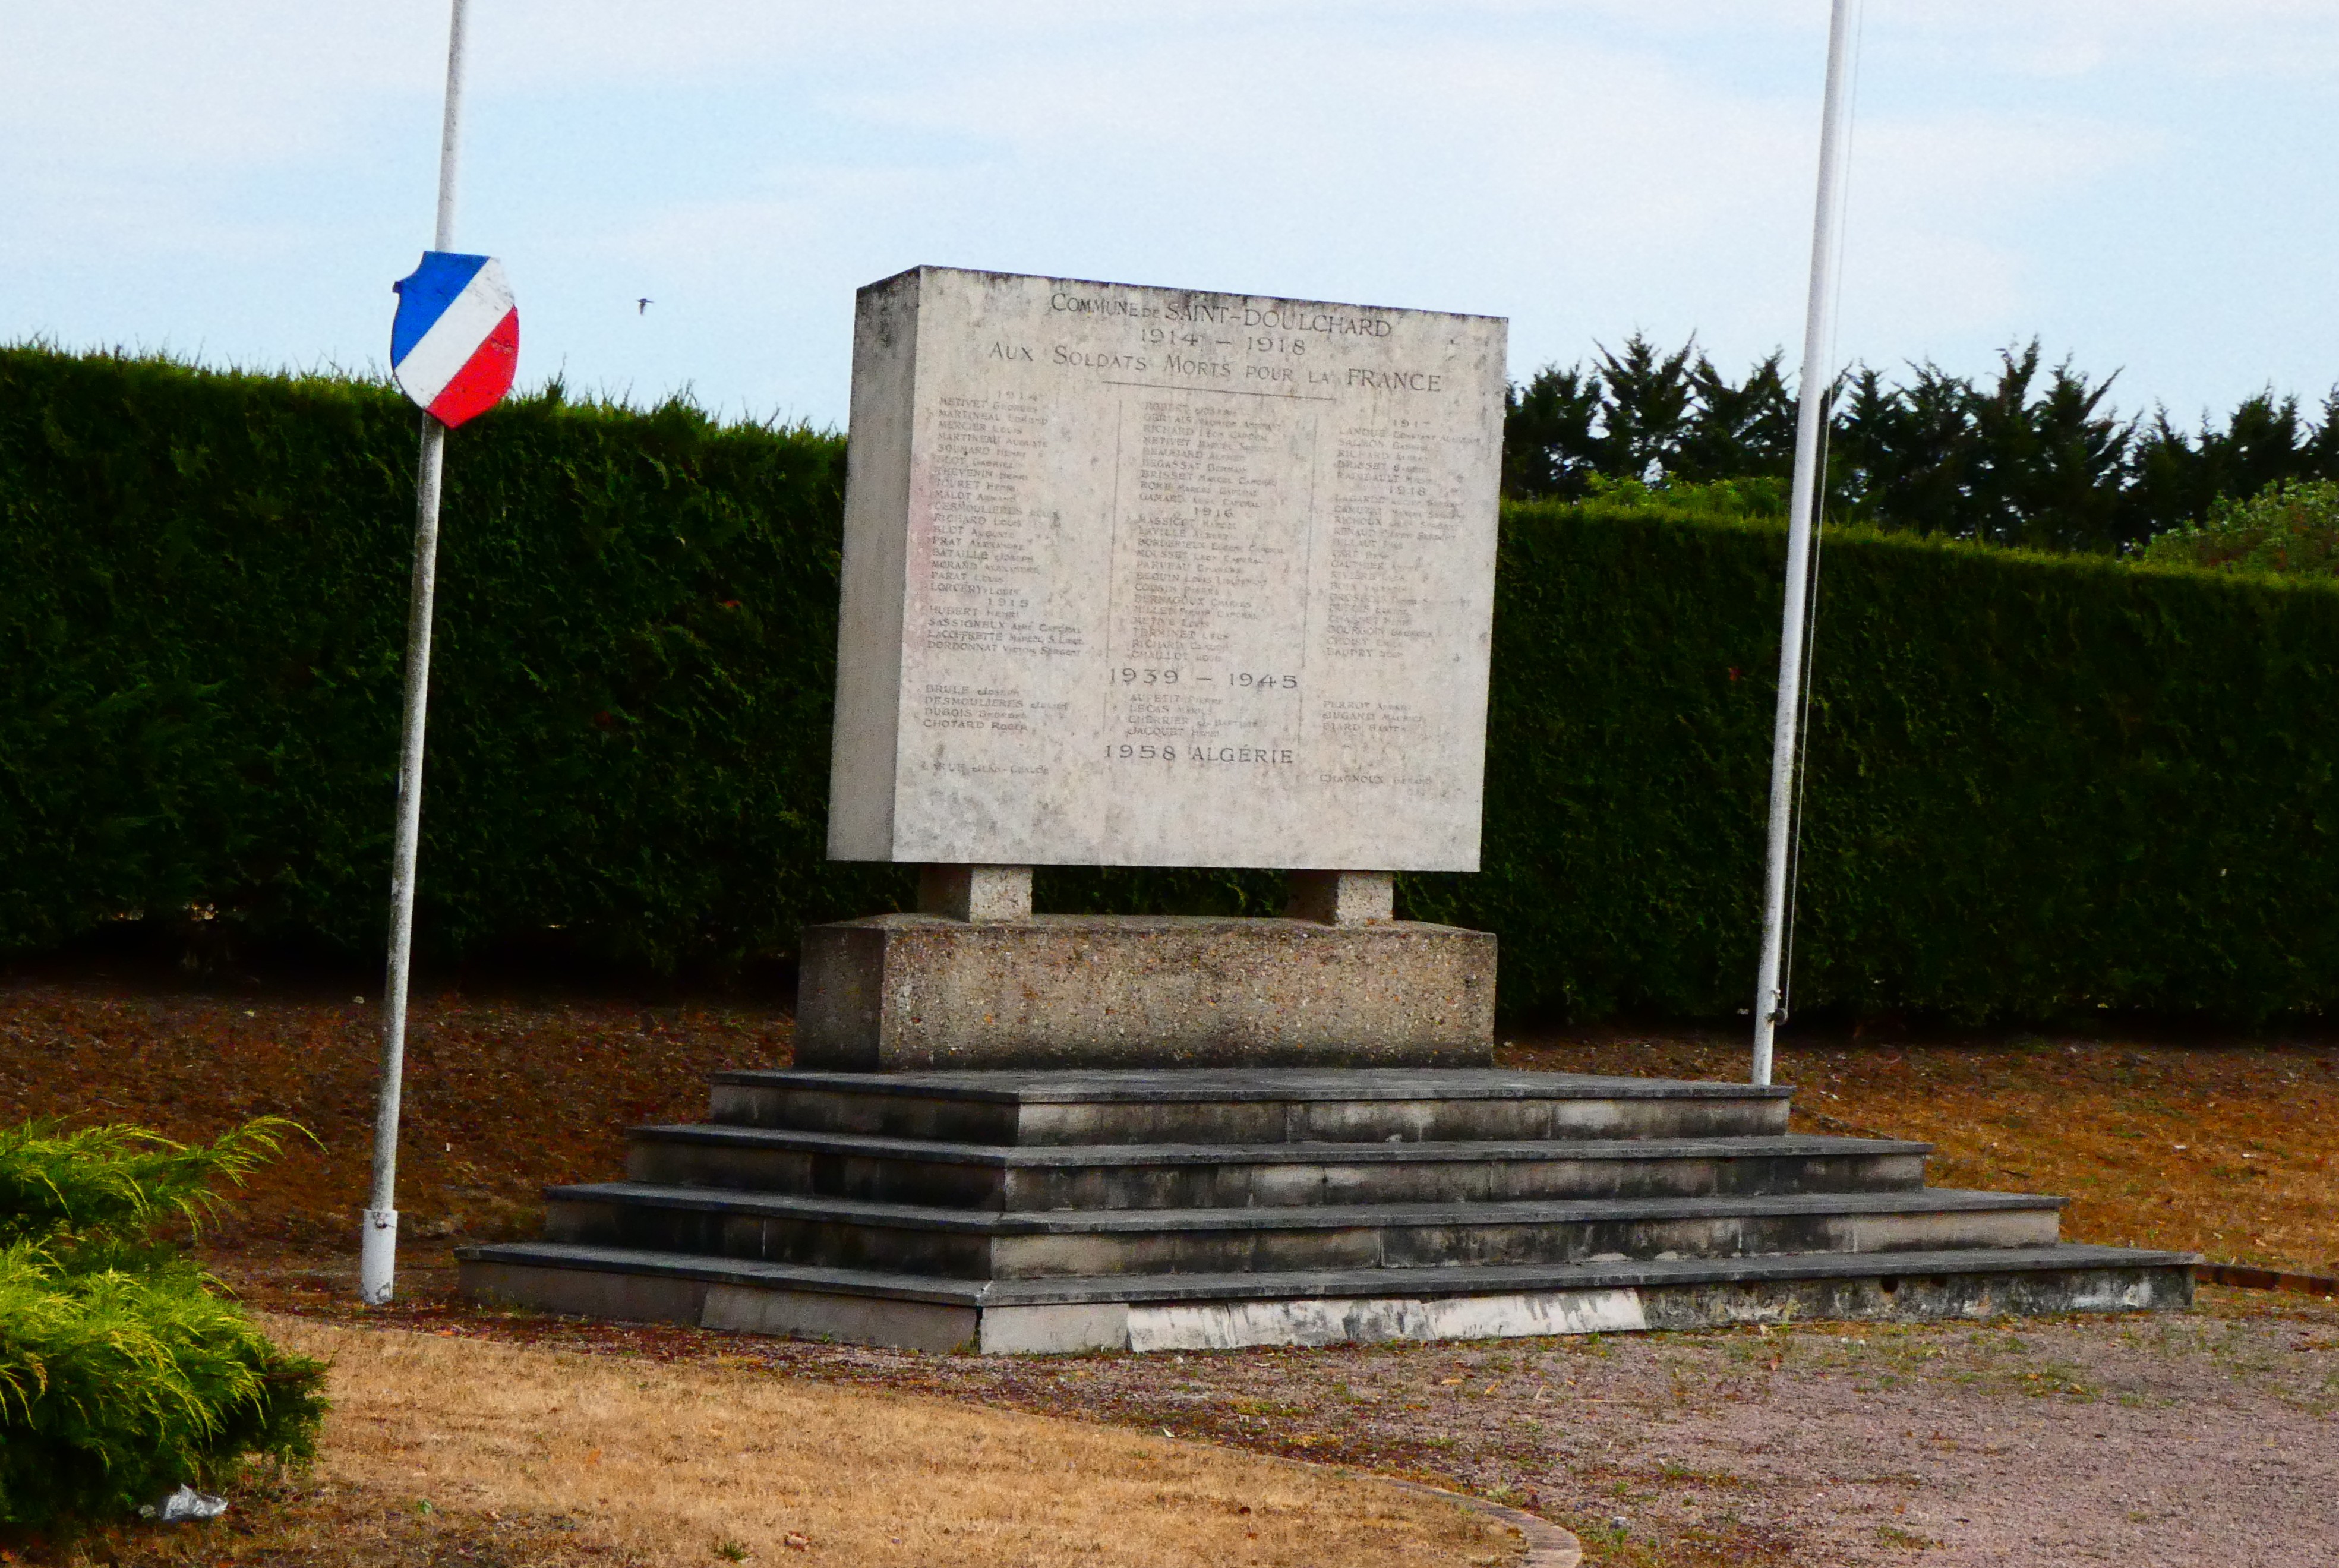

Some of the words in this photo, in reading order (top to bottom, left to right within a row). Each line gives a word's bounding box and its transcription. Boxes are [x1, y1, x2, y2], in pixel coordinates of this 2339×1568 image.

[1164, 302, 1392, 338] SAINT-DOULCHARD
[1140, 328, 1199, 347] 1914
[1246, 336, 1306, 356] 1918
[989, 340, 1034, 362] AUX
[1052, 345, 1147, 371] SOLDATS
[1164, 354, 1232, 378] MORTS
[1246, 365, 1294, 383] POUR
[1308, 370, 1330, 384] LA
[1347, 369, 1441, 392] FRANCE
[1389, 486, 1426, 496] 1918
[1194, 507, 1233, 518] 1916
[988, 598, 1029, 608] 1915
[1109, 667, 1179, 684] 1939
[1230, 673, 1298, 689] 1945
[923, 718, 985, 729] CHOTARD
[1105, 743, 1177, 761] 1958
[1191, 744, 1294, 765] ALGÉRIE
